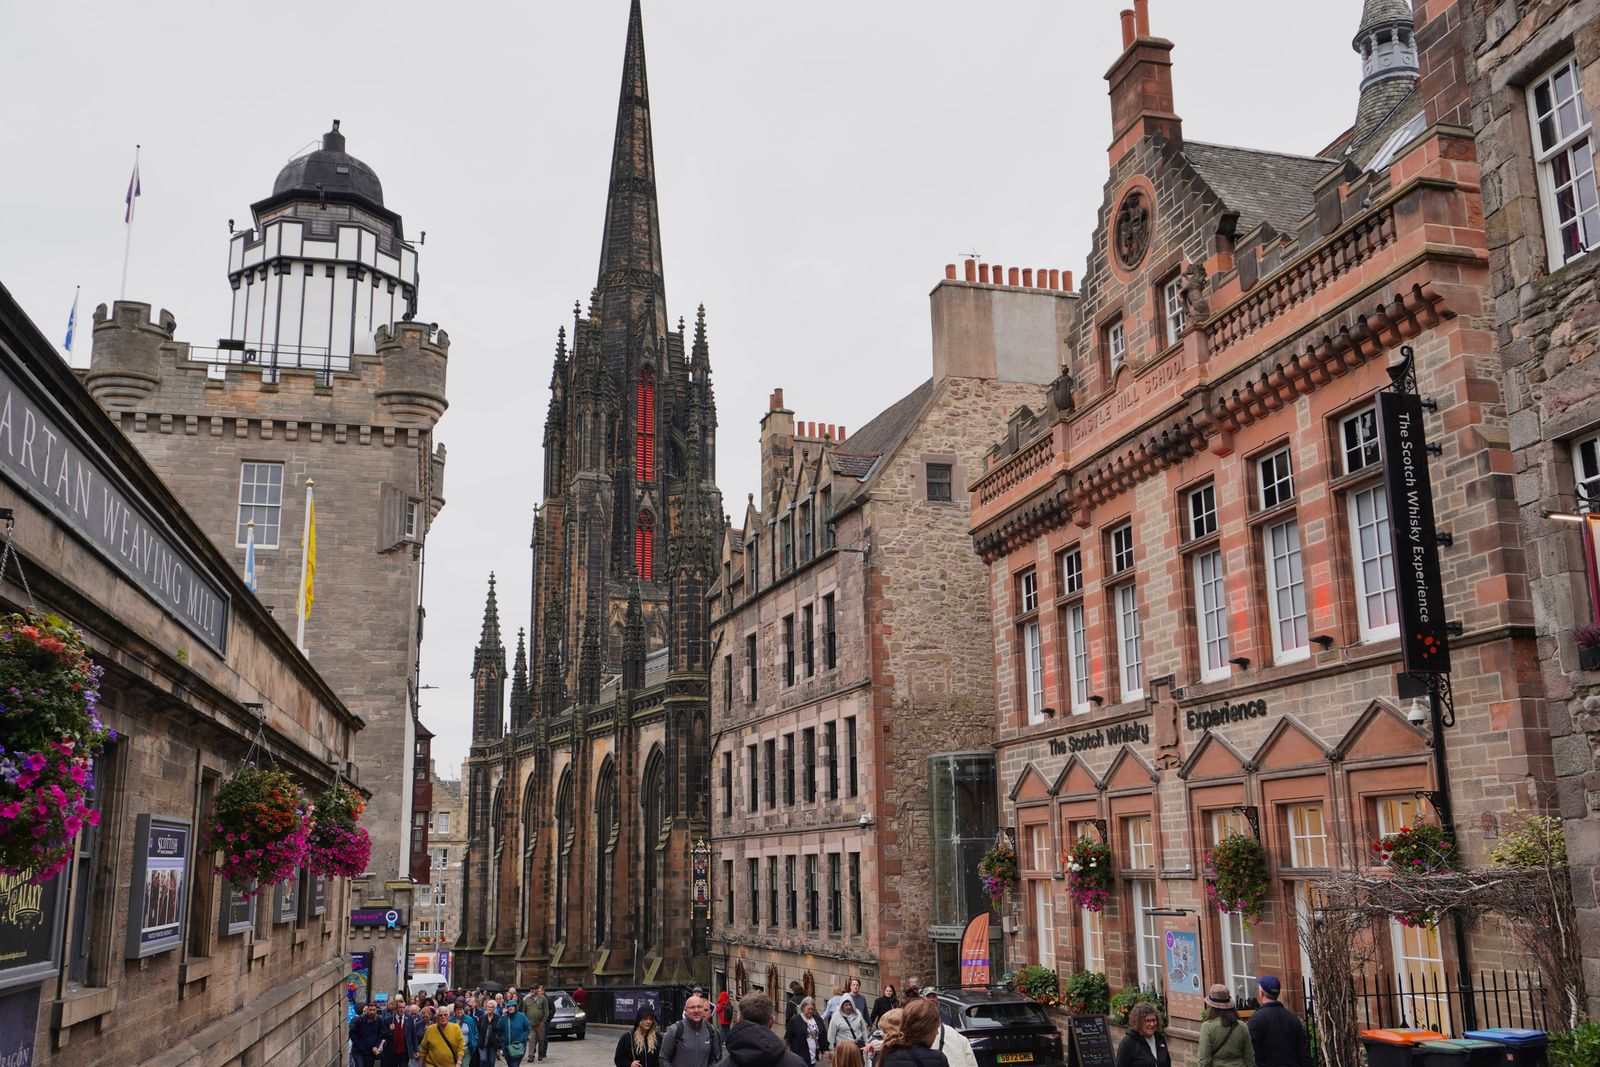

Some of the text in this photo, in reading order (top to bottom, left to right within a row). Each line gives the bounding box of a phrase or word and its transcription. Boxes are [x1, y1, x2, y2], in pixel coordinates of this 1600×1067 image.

[1075, 354, 1187, 441] CASTLE HILL SCHOOL
[0, 390, 216, 638] ARTAN WEAVING MILL
[1398, 412, 1430, 623] The Scotch Whisky Experience
[1048, 698, 1267, 756] The Scotch Whisky Experience
[9, 883, 43, 924] GALAXY
[0, 1047, 30, 1067] RAGON
